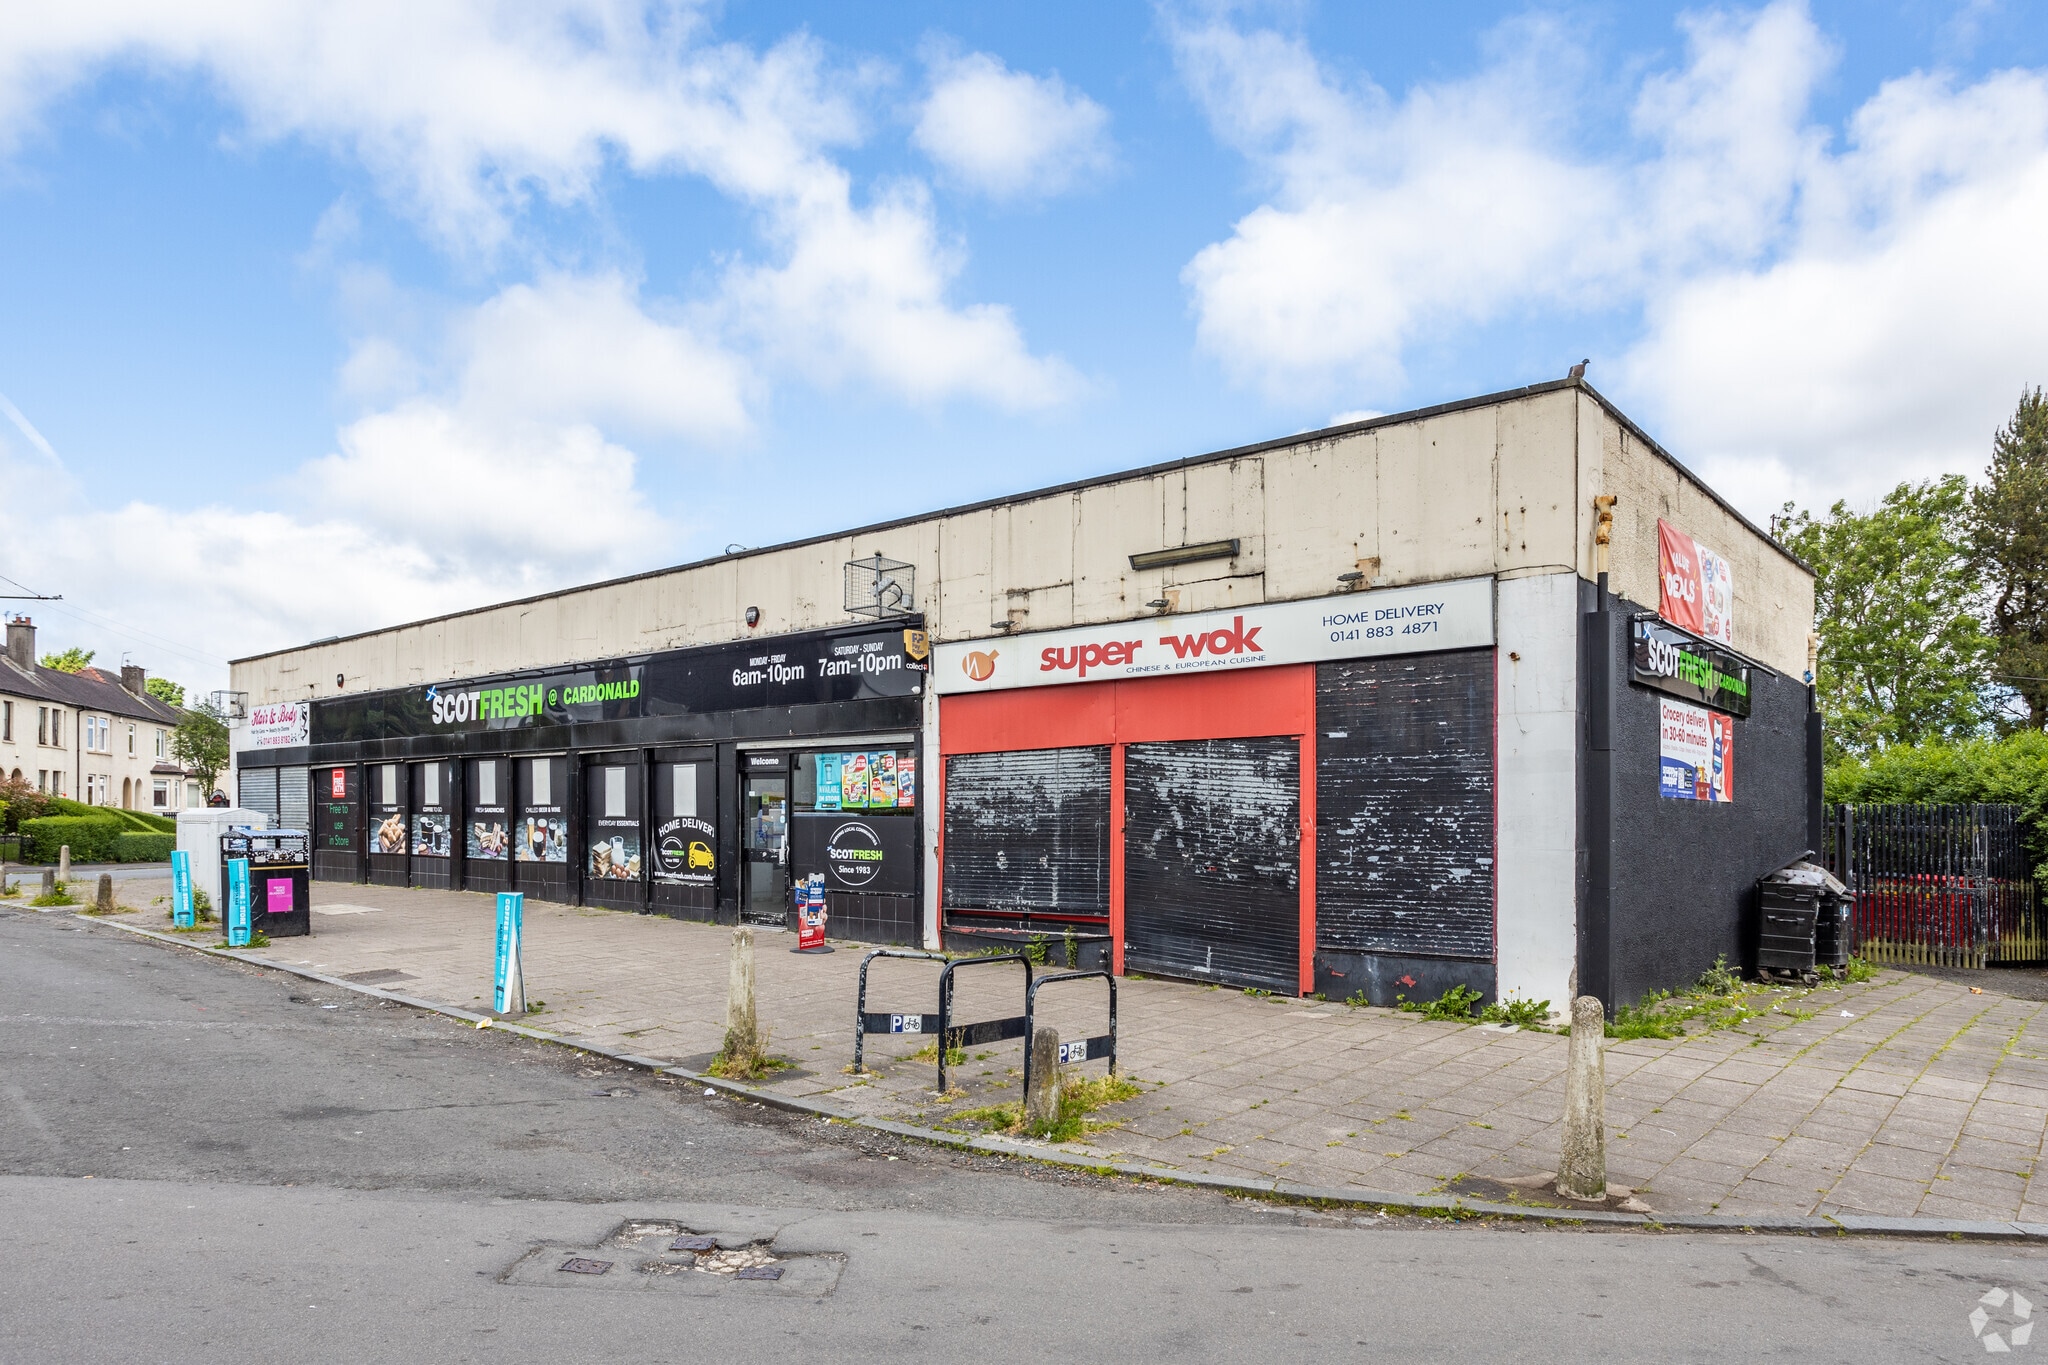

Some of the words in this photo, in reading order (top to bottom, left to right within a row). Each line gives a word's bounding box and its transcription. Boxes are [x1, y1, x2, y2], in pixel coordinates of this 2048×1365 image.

[1672, 552, 1690, 574] VALUE
[1666, 573, 1696, 603] DEALS
[1322, 611, 1369, 627] HOME
[1375, 602, 1445, 621] DELIVERY
[1330, 629, 1360, 643] 0141
[1366, 625, 1394, 639] 883
[1401, 621, 1438, 635] 4871
[834, 644, 860, 656] SATURDAY
[863, 641, 884, 653] SUNDAY
[1039, 639, 1143, 678] super
[1159, 615, 1265, 659] wok
[749, 656, 768, 667] MONDAY
[771, 653, 786, 664] FRIDAY
[818, 652, 902, 677] 7am-10pm
[1126, 664, 1161, 674] CHINESE
[1175, 659, 1226, 670] EUROPEAN
[1230, 654, 1267, 665] CUISINE
[1647, 637, 1713, 690] SCOTFRESH
[1719, 672, 1747, 697] CARDONALD
[732, 663, 805, 687] 6am-10pm
[431, 683, 543, 725] SCOTFRESH
[548, 688, 557, 707] @
[563, 679, 640, 705] CARDONALD
[251, 709, 268, 727] Hair
[269, 708, 276, 725] &
[278, 704, 297, 728] Body
[1662, 704, 1686, 727] Grocery
[1686, 710, 1707, 732] delivery
[1662, 723, 1669, 740] in
[1669, 726, 1686, 742] 30-60
[1686, 729, 1707, 747] minutes
[750, 757, 780, 766] Welcome
[330, 803, 341, 814] Free
[342, 805, 349, 814] to
[333, 821, 344, 830] use
[598, 819, 616, 827] EVERYDAY
[658, 819, 680, 838] HOME
[329, 835, 334, 845] in
[334, 834, 349, 846] Store
[830, 849, 883, 861] SCOTFRESH
[838, 864, 855, 874] Since
[855, 865, 871, 875] 1983
[893, 1016, 903, 1033] P
[1059, 1045, 1068, 1063] P
